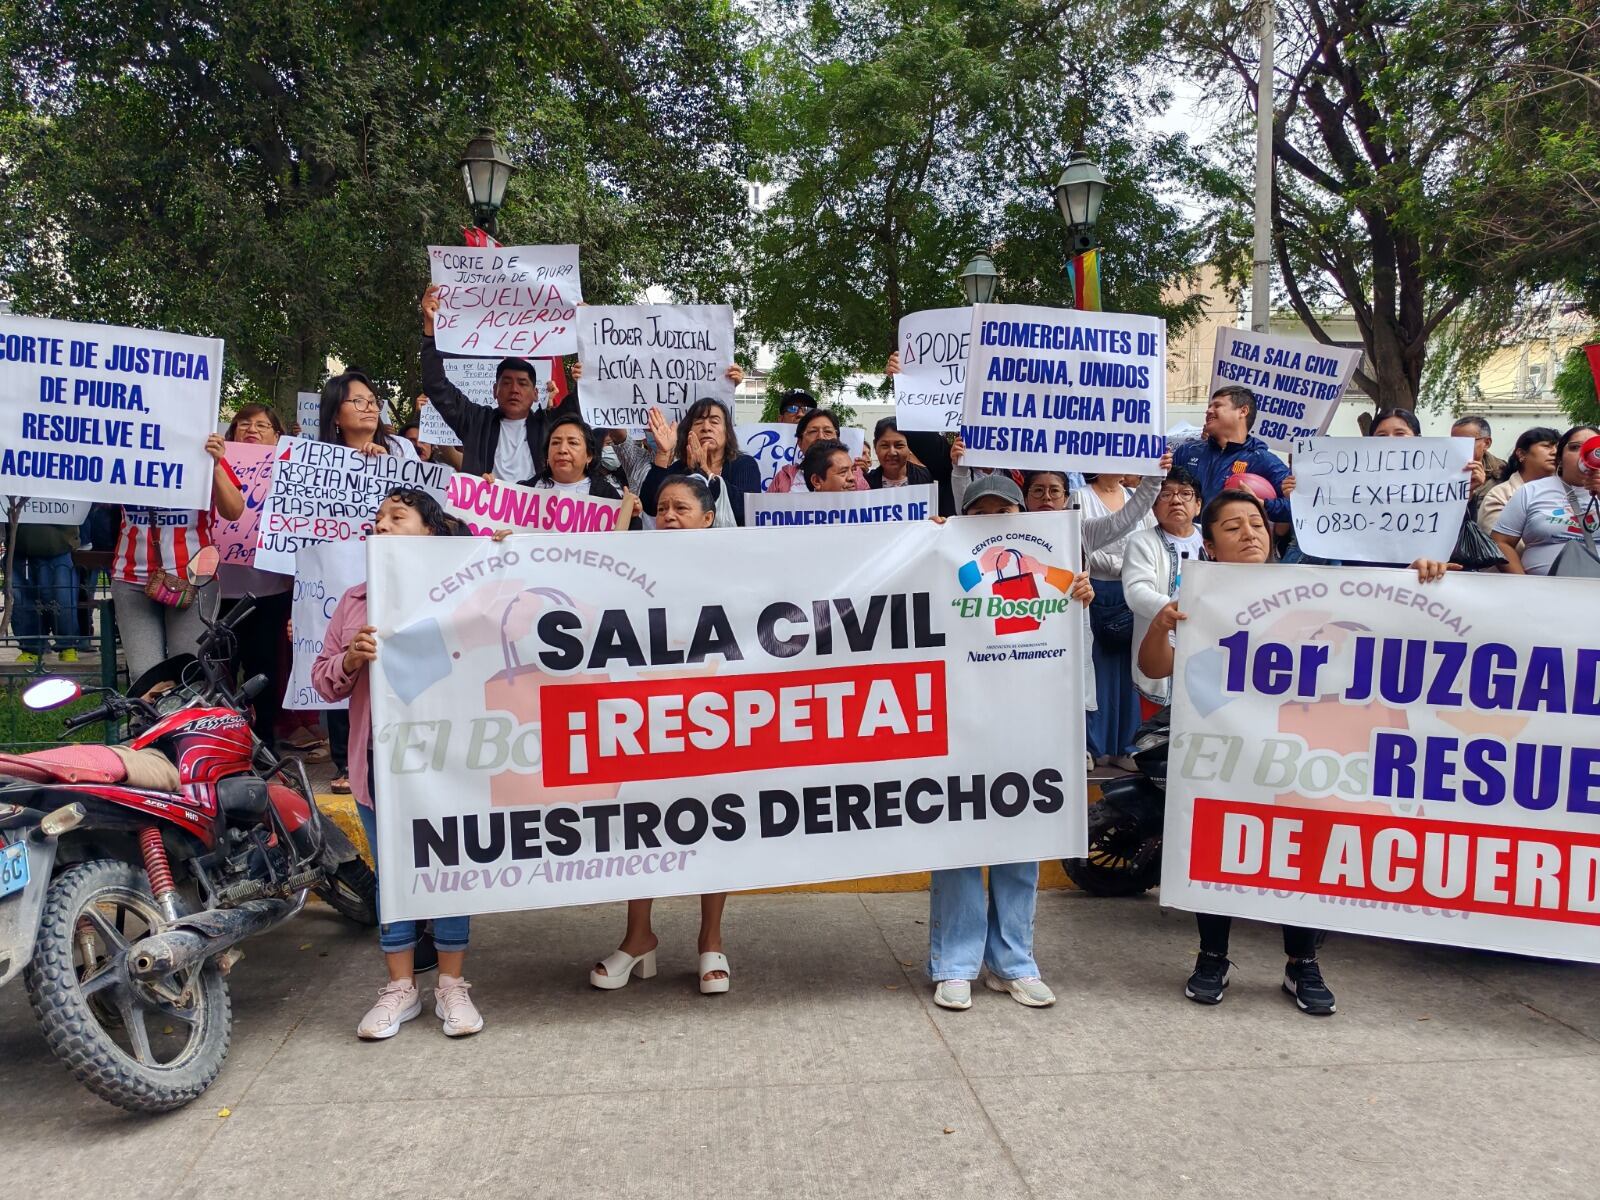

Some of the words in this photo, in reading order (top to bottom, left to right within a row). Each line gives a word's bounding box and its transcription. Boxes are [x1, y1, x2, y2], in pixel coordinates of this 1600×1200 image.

[454, 271, 507, 284] JUSTICIA
[511, 271, 529, 282] DE
[536, 264, 573, 281] PIURA
[492, 256, 519, 269] DE
[437, 284, 564, 309] RESUELVA
[436, 314, 460, 330] DE
[476, 308, 575, 330] ACUERDO
[646, 315, 717, 351] JUDICIAL
[461, 332, 480, 348] A
[1137, 333, 1159, 357] DE
[70, 340, 99, 369] DE
[105, 344, 210, 380] JUSTICIA
[987, 357, 1073, 387] ADCUNA,
[1079, 362, 1149, 389] UNIDOS
[1230, 340, 1261, 362] 1ERA
[1264, 348, 1301, 370] SALA
[1305, 355, 1339, 378] CIVIL
[940, 364, 965, 386] JU
[1217, 360, 1270, 388] RESPETA
[1272, 373, 1343, 401] NUESTROS
[40, 376, 67, 404] DE
[74, 379, 150, 414] PIURA,
[632, 384, 647, 404] A
[897, 391, 963, 406] RESUELVE
[981, 391, 1007, 417] EN
[1013, 393, 1036, 418] LA
[1042, 395, 1105, 422] LUCHA
[1112, 398, 1151, 424] POR
[1253, 393, 1306, 420] RECHOS
[22, 412, 134, 448] RESUELVE
[140, 424, 165, 451] EL
[961, 425, 1048, 451] NUESTRA
[1, 449, 103, 483] ACUERDO
[110, 459, 127, 485] A
[134, 460, 184, 489] LEY!
[279, 461, 341, 488] RESPETA
[350, 450, 398, 479] SALA
[1312, 450, 1447, 476] SOLUCION
[275, 481, 347, 502] DERECHOS
[352, 491, 372, 505] DE
[447, 475, 540, 529] ADCUNA
[1313, 483, 1336, 508] AL
[1352, 480, 1470, 505] EXPEDIENTE
[1316, 512, 1439, 534] 0830-2021
[971, 535, 1003, 556] CENTRO
[1006, 533, 1054, 553] COMERCIAL
[429, 550, 520, 603] CENTRO
[530, 547, 657, 599] COMERCIAL
[987, 597, 1069, 620] Bosque
[1235, 582, 1329, 626] CENTRO
[1339, 580, 1473, 637] COMERCIAL
[538, 605, 744, 671] SALA
[756, 592, 946, 659] CIVIL
[967, 651, 1007, 663] Nuevo
[1008, 648, 1067, 661] Amanecer
[1219, 630, 1329, 697] 1er
[568, 672, 933, 775] ¡RESPETA!
[412, 794, 747, 869] NUESTROS
[759, 768, 1065, 838] DERECHOS
[1220, 812, 1303, 881] DE
[412, 862, 522, 895] Nuevo
[528, 848, 697, 885] Amanecer
